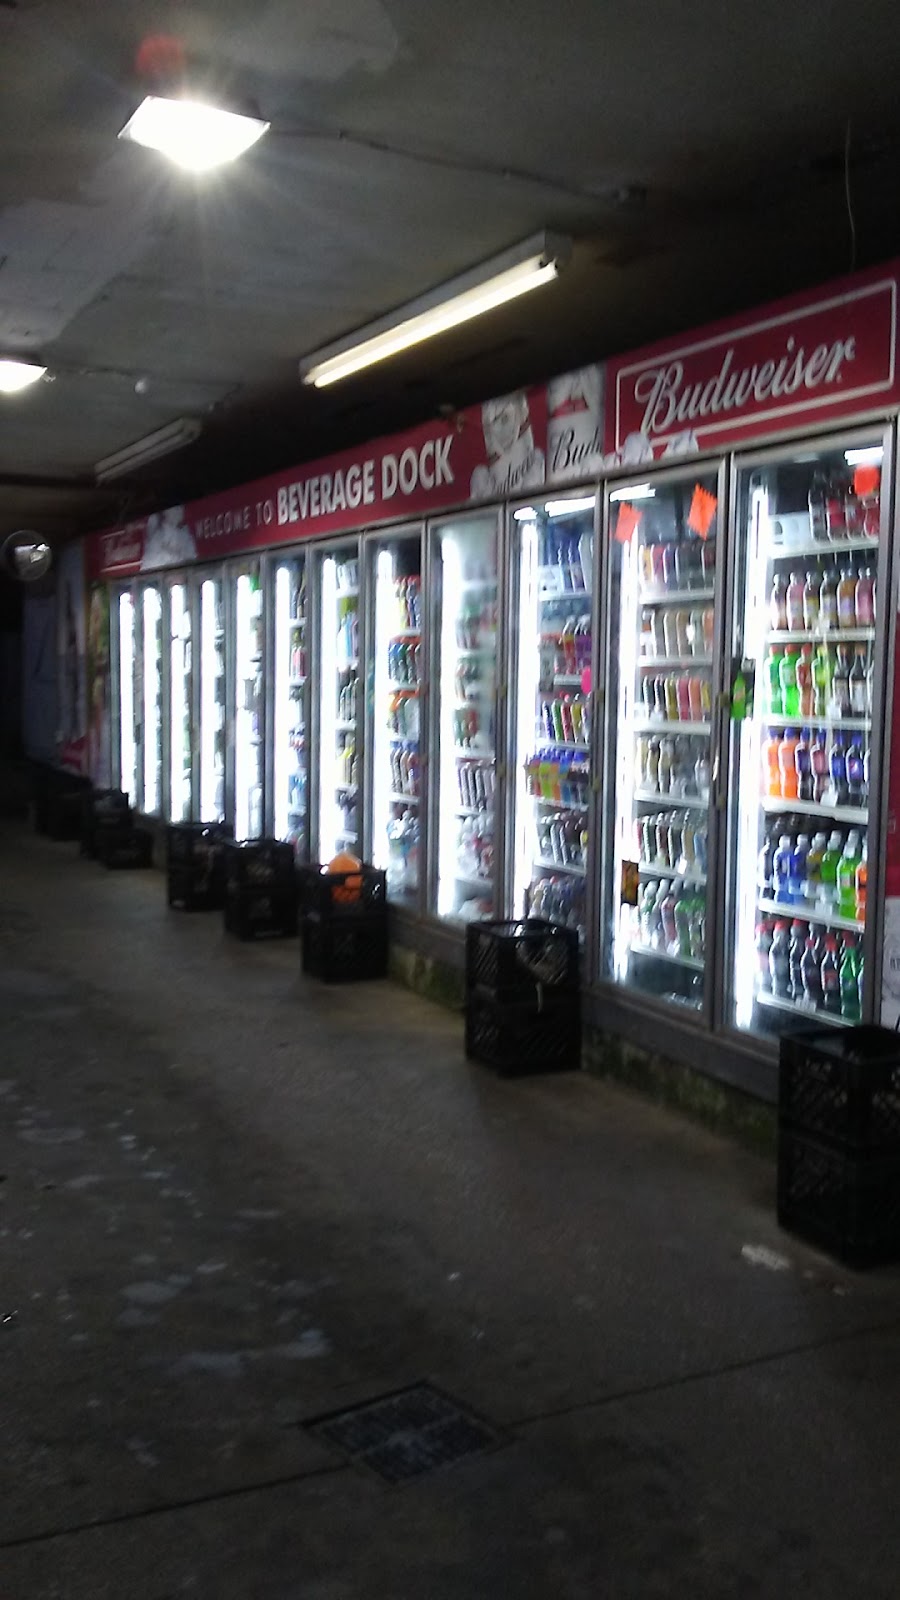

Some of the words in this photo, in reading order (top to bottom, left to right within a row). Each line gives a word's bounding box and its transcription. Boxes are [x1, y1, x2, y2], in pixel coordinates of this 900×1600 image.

[634, 336, 856, 437] Budweiser
[195, 505, 251, 540] WELCOME
[256, 501, 272, 526] TO
[277, 459, 375, 526] BEVERAGE
[381, 435, 454, 500] DOCK
